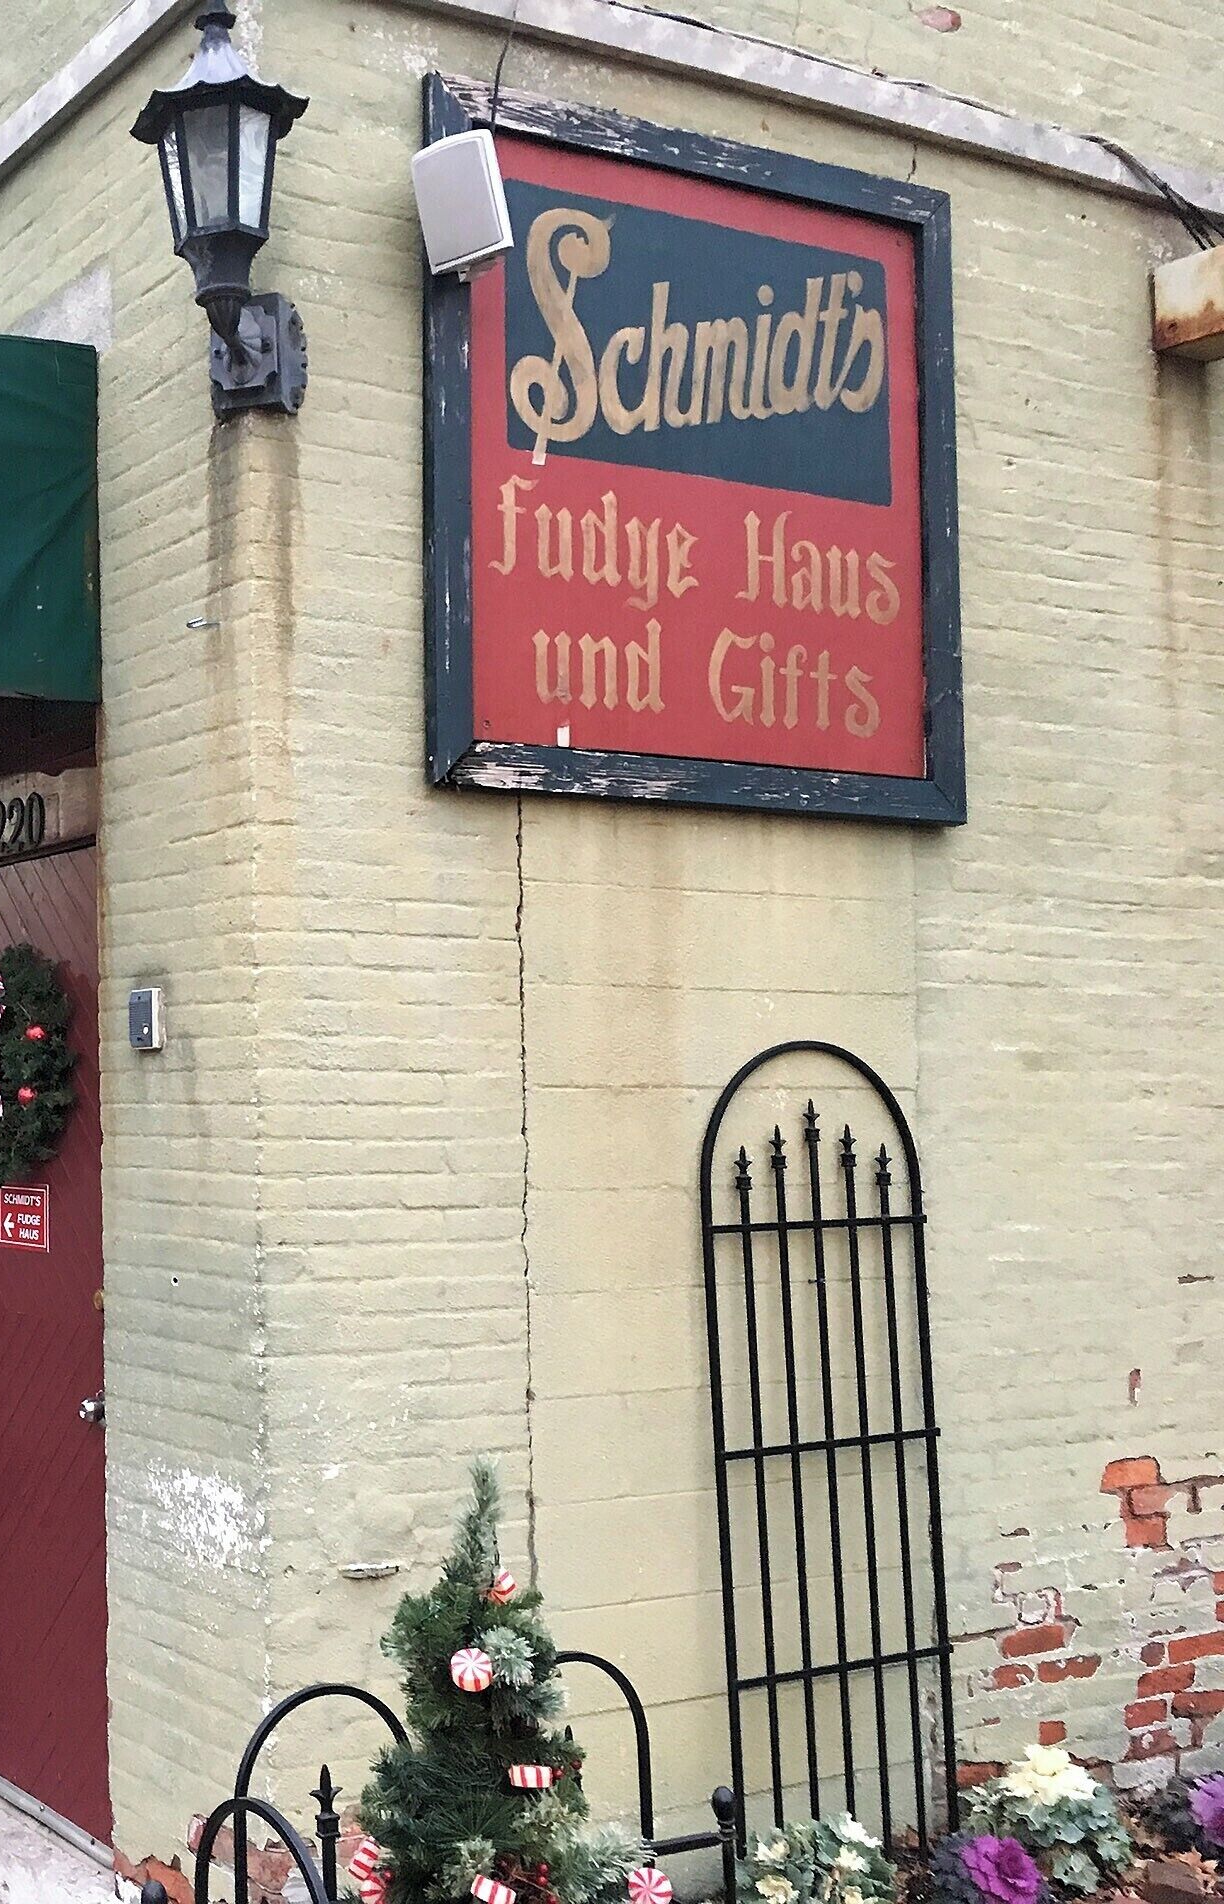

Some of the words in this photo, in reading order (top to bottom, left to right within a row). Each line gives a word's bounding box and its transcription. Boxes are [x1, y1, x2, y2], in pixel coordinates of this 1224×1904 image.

[510, 208, 885, 465] Schmidt's
[736, 510, 901, 626] Haus
[532, 617, 665, 714] und
[708, 627, 882, 739] Gifts
[3, 1193, 42, 1206] SCHMIDT'S
[17, 1213, 41, 1226] FUDGE
[19, 1228, 40, 1240] HAUS
